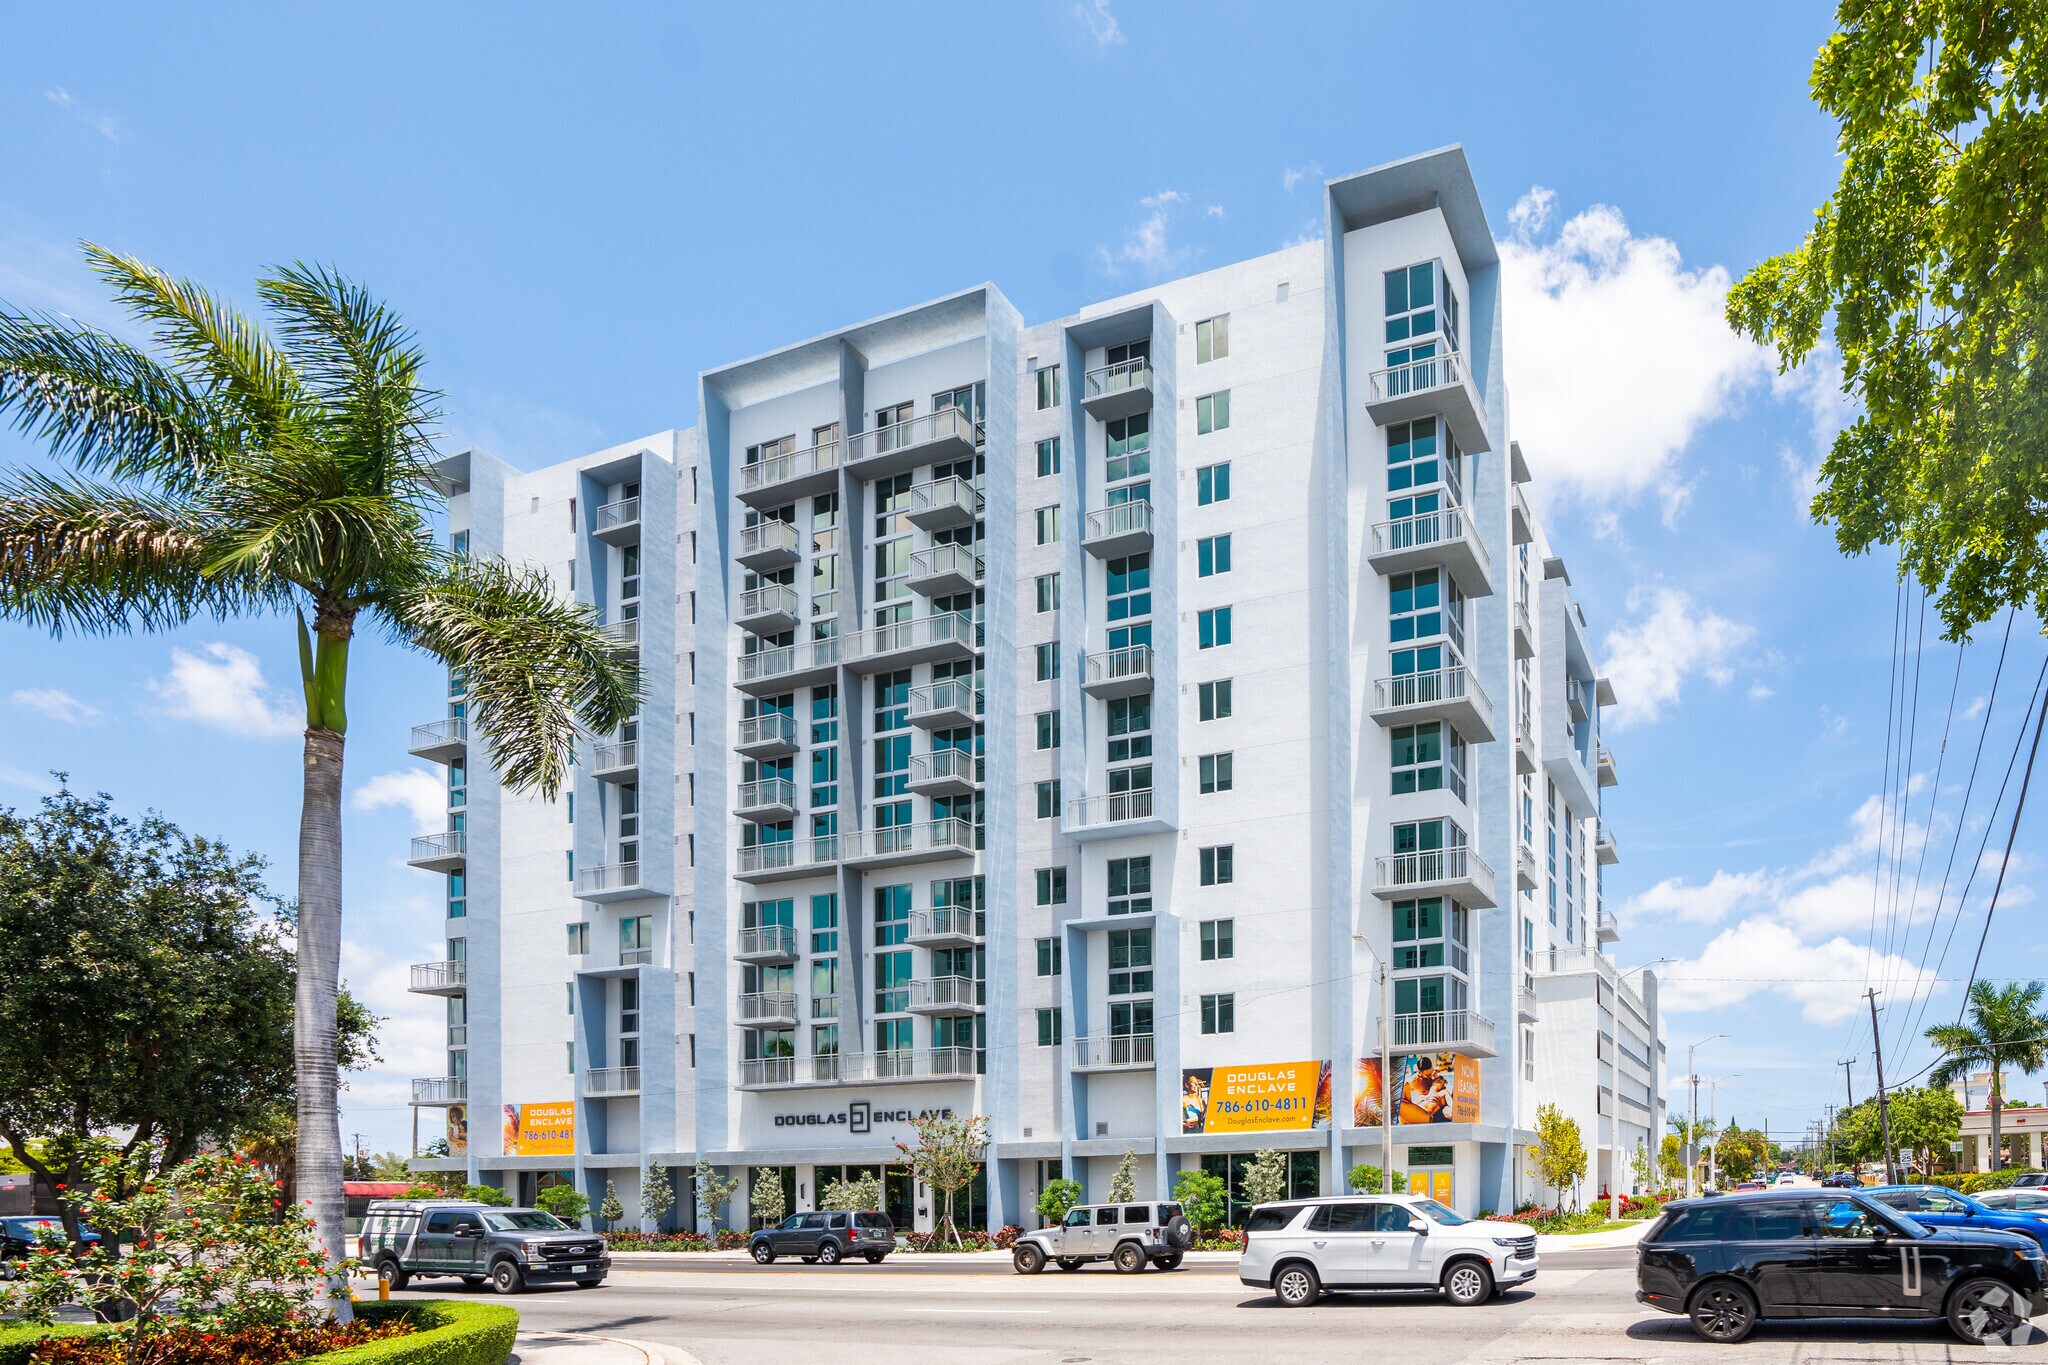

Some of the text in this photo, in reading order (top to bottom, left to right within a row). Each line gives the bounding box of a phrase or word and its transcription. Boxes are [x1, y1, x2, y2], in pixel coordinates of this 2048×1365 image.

[1227, 1070, 1296, 1083] DOUGLAS
[1461, 1064, 1474, 1079] NOW
[1227, 1083, 1296, 1095] ENCLAVE
[1457, 1079, 1479, 1096] LEASING
[1216, 1097, 1306, 1113] 786-610-4811
[530, 1108, 572, 1117] DOUGLAS
[774, 1109, 952, 1126] DOUGLAS ENCLAVE
[530, 1118, 572, 1126] ENCLAVE
[1228, 1116, 1296, 1126] DouglasEnclave.com
